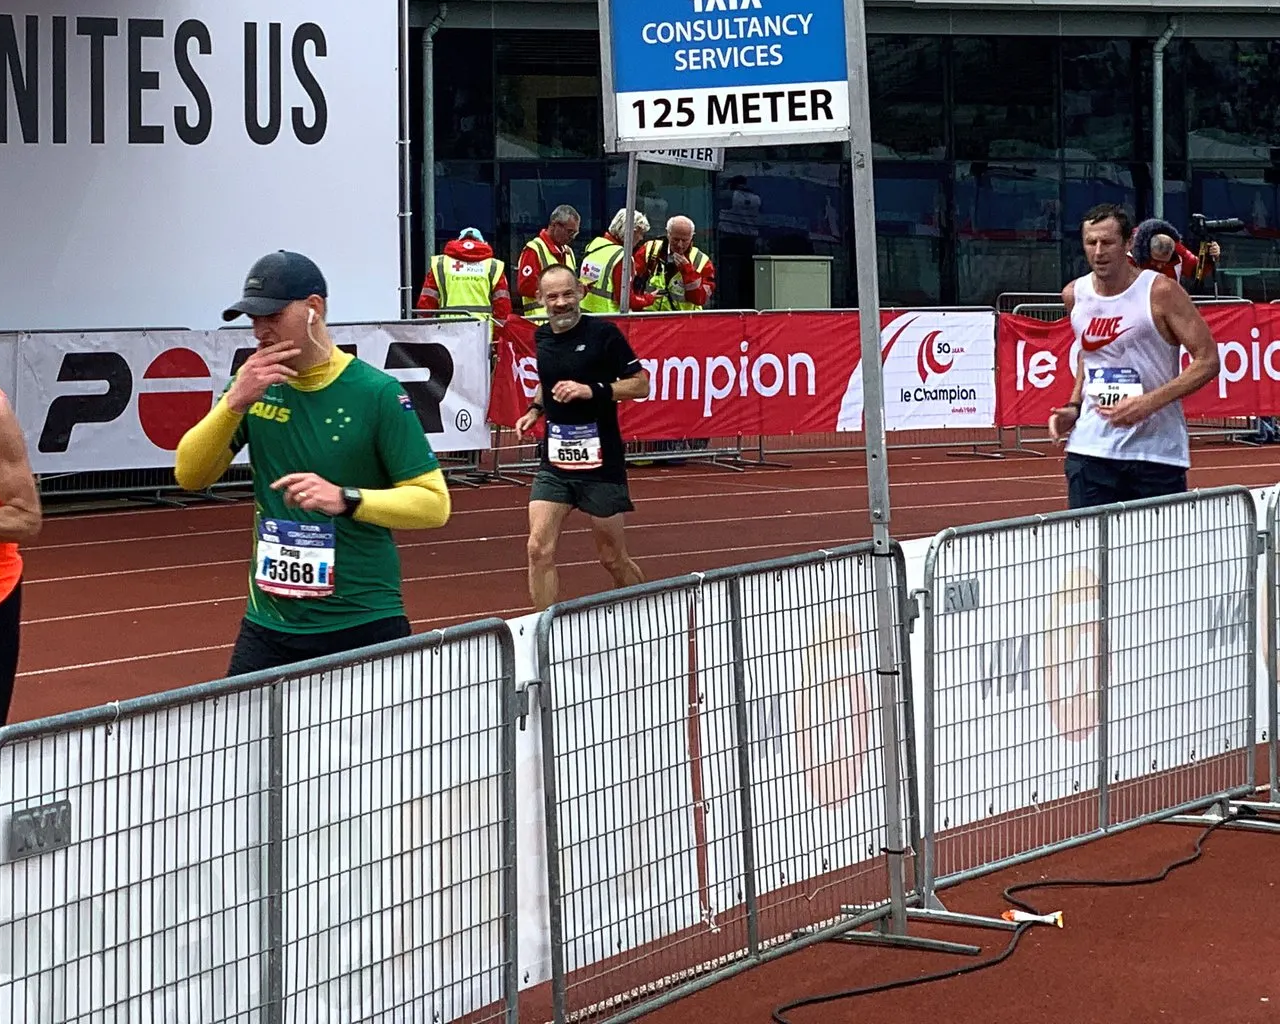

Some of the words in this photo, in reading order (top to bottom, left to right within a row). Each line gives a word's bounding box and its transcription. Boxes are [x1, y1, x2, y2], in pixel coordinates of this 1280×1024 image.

[642, 13, 813, 45] CONSULTANCY
[674, 44, 783, 71] SERVICES
[243, 22, 329, 146] US
[632, 97, 695, 129] 125
[707, 89, 834, 125] METER
[1087, 316, 1123, 336] NIKE
[936, 343, 951, 354] 50
[1016, 340, 1059, 391] le
[631, 341, 816, 417] ampion
[900, 388, 911, 402] le
[914, 385, 976, 404] Champion
[249, 401, 291, 423] AUS
[280, 546, 300, 559] Craig
[269, 559, 313, 584] 5368
